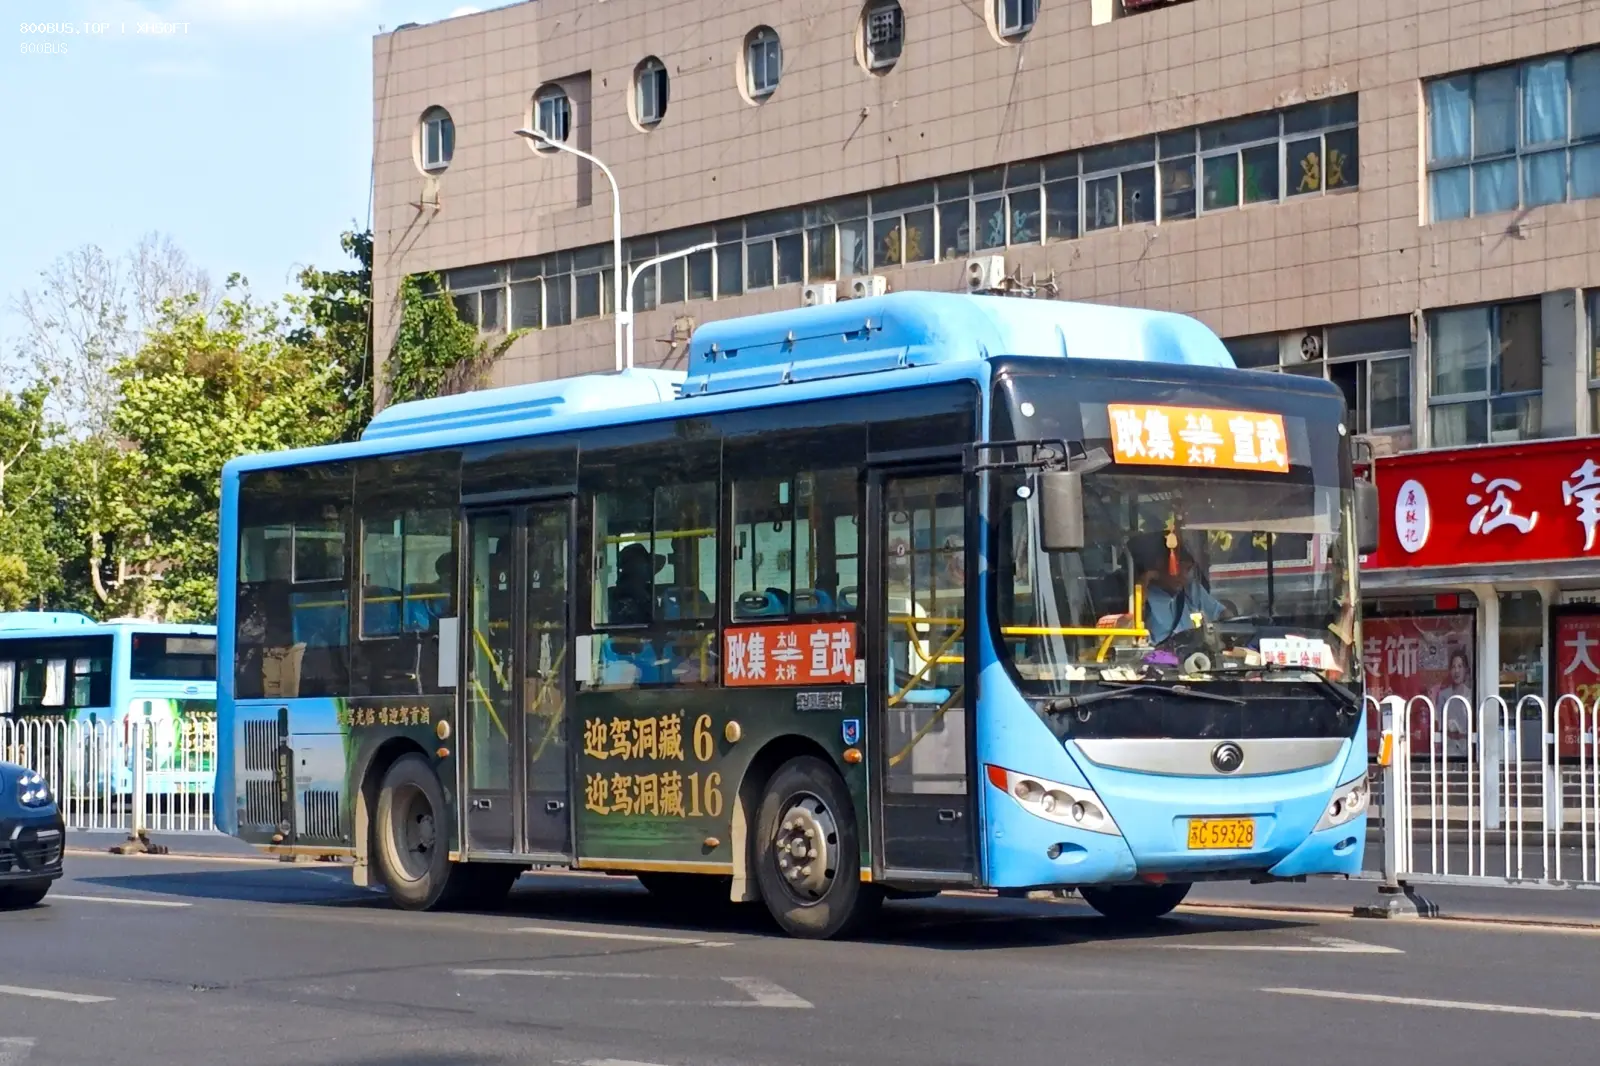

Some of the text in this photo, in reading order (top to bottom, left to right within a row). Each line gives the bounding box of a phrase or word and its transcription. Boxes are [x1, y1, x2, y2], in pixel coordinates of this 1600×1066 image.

[1228, 415, 1286, 468] 宣武
[727, 631, 767, 680] 耿集
[775, 663, 797, 681] 大许
[809, 627, 852, 677] 宣武
[583, 713, 684, 761] 迎驾洞藏
